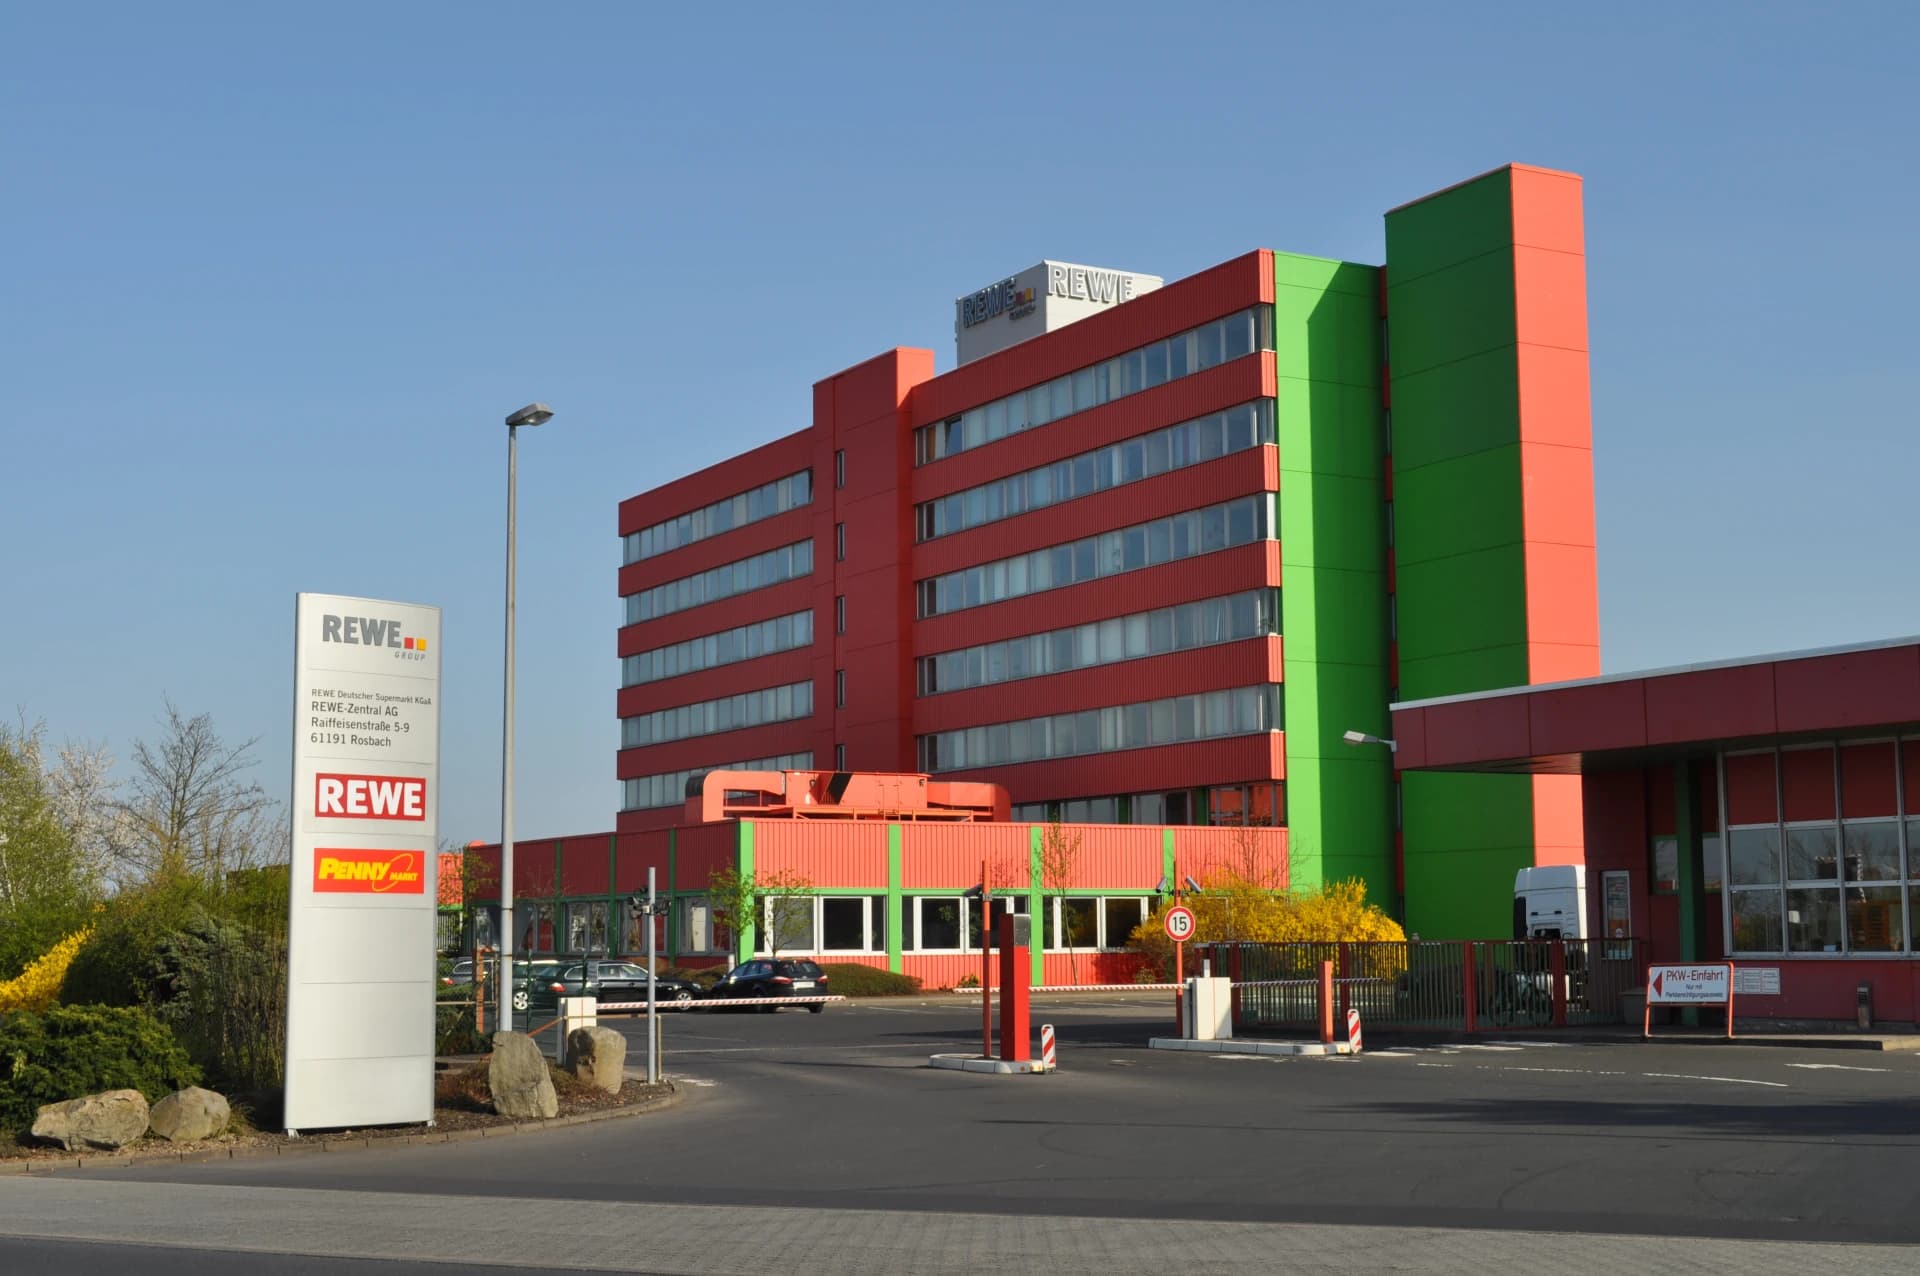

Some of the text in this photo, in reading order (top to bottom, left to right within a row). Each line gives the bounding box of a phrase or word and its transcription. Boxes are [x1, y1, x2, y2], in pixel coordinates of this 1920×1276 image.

[1047, 264, 1133, 304] REWE
[962, 278, 1017, 328] REWE
[322, 614, 402, 649] REWE
[394, 651, 426, 661] GROUP
[311, 688, 432, 705] REWE Deutscher Supermarkt KGaA
[311, 701, 399, 717] REWE-Zentral AG
[311, 716, 410, 733] Raiffeisenstraße 5-9
[310, 732, 392, 747] 61191 Rosbach
[318, 777, 423, 817] REWE
[318, 857, 419, 882] PENNY MARKT
[1172, 916, 1187, 932] 15
[1666, 969, 1724, 981] PKW-Einfahrt
